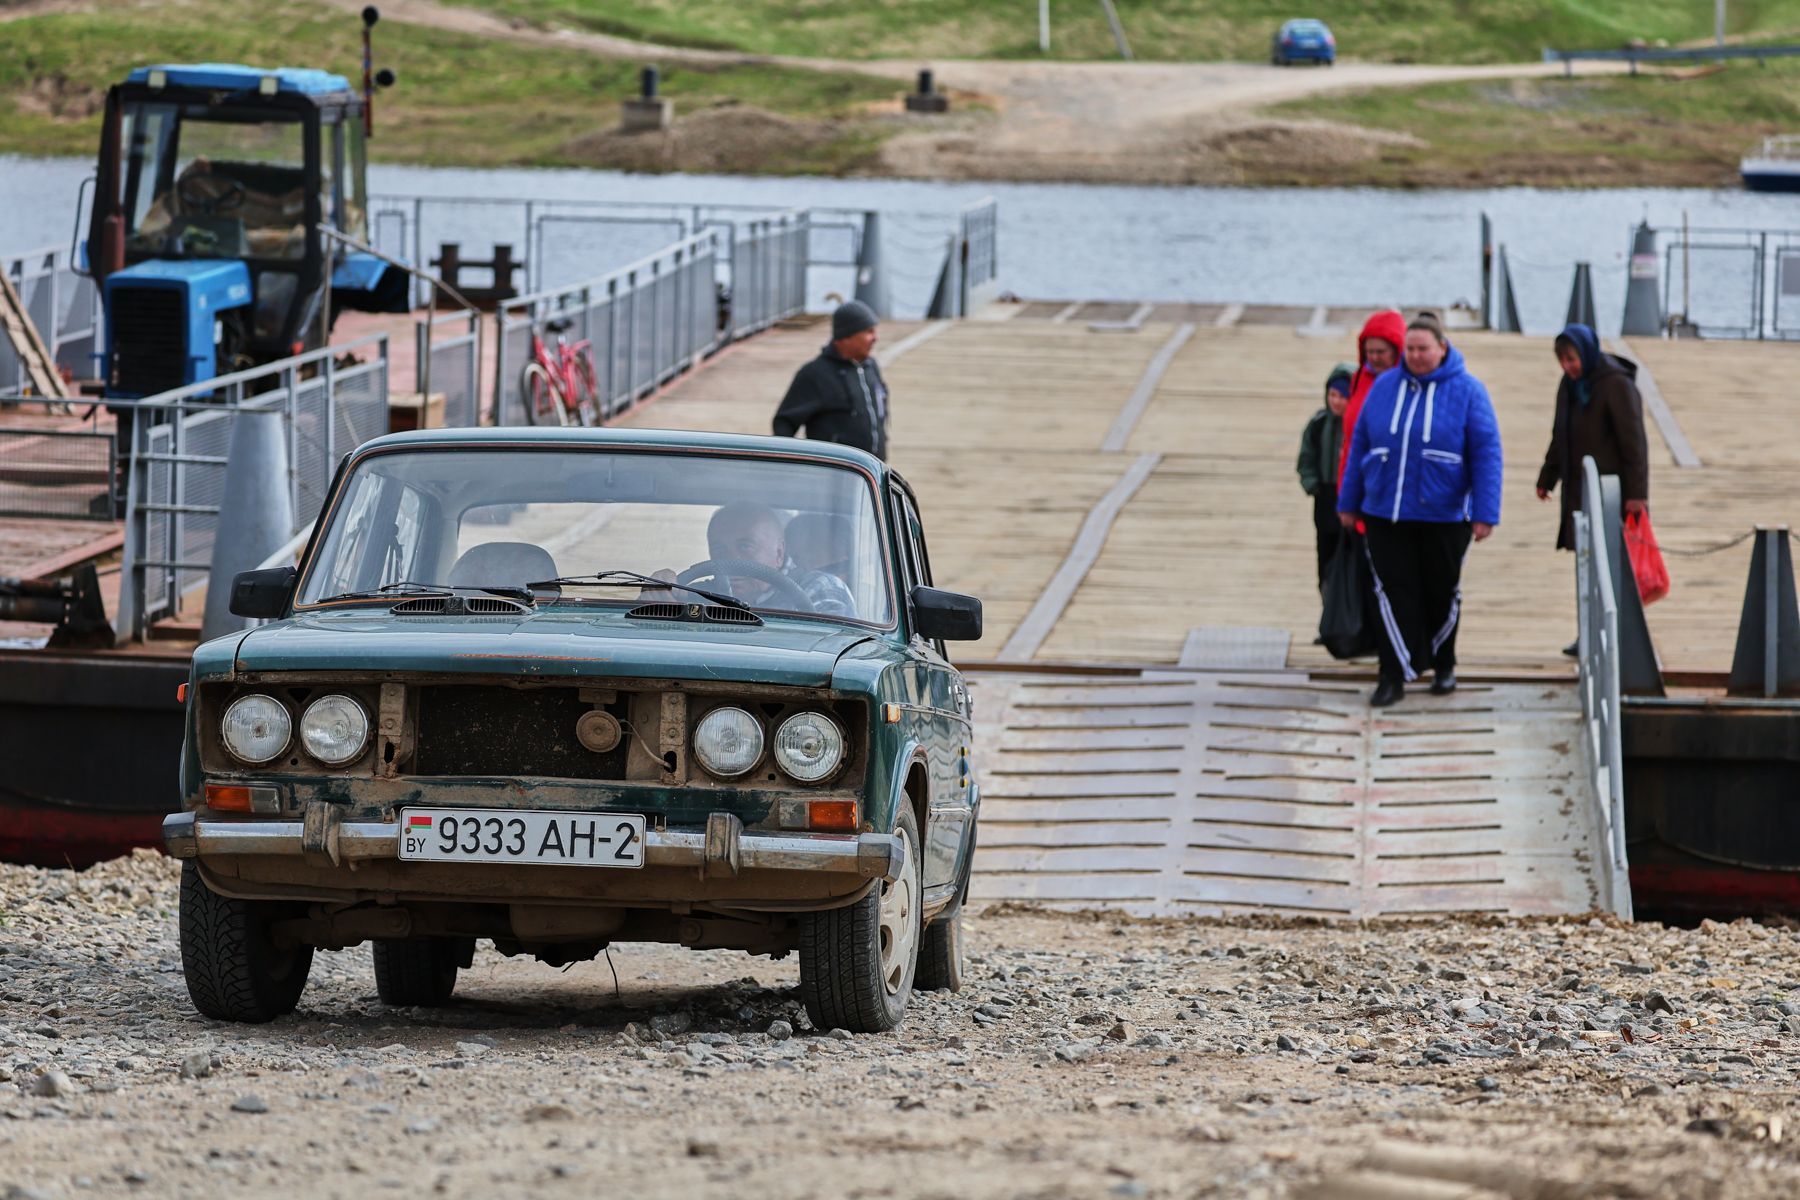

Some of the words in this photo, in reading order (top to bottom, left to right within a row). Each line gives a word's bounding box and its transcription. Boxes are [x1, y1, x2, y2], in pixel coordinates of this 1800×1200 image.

[406, 837, 426, 853] BY
[439, 816, 526, 855] 9333
[537, 819, 636, 860] AH-2
